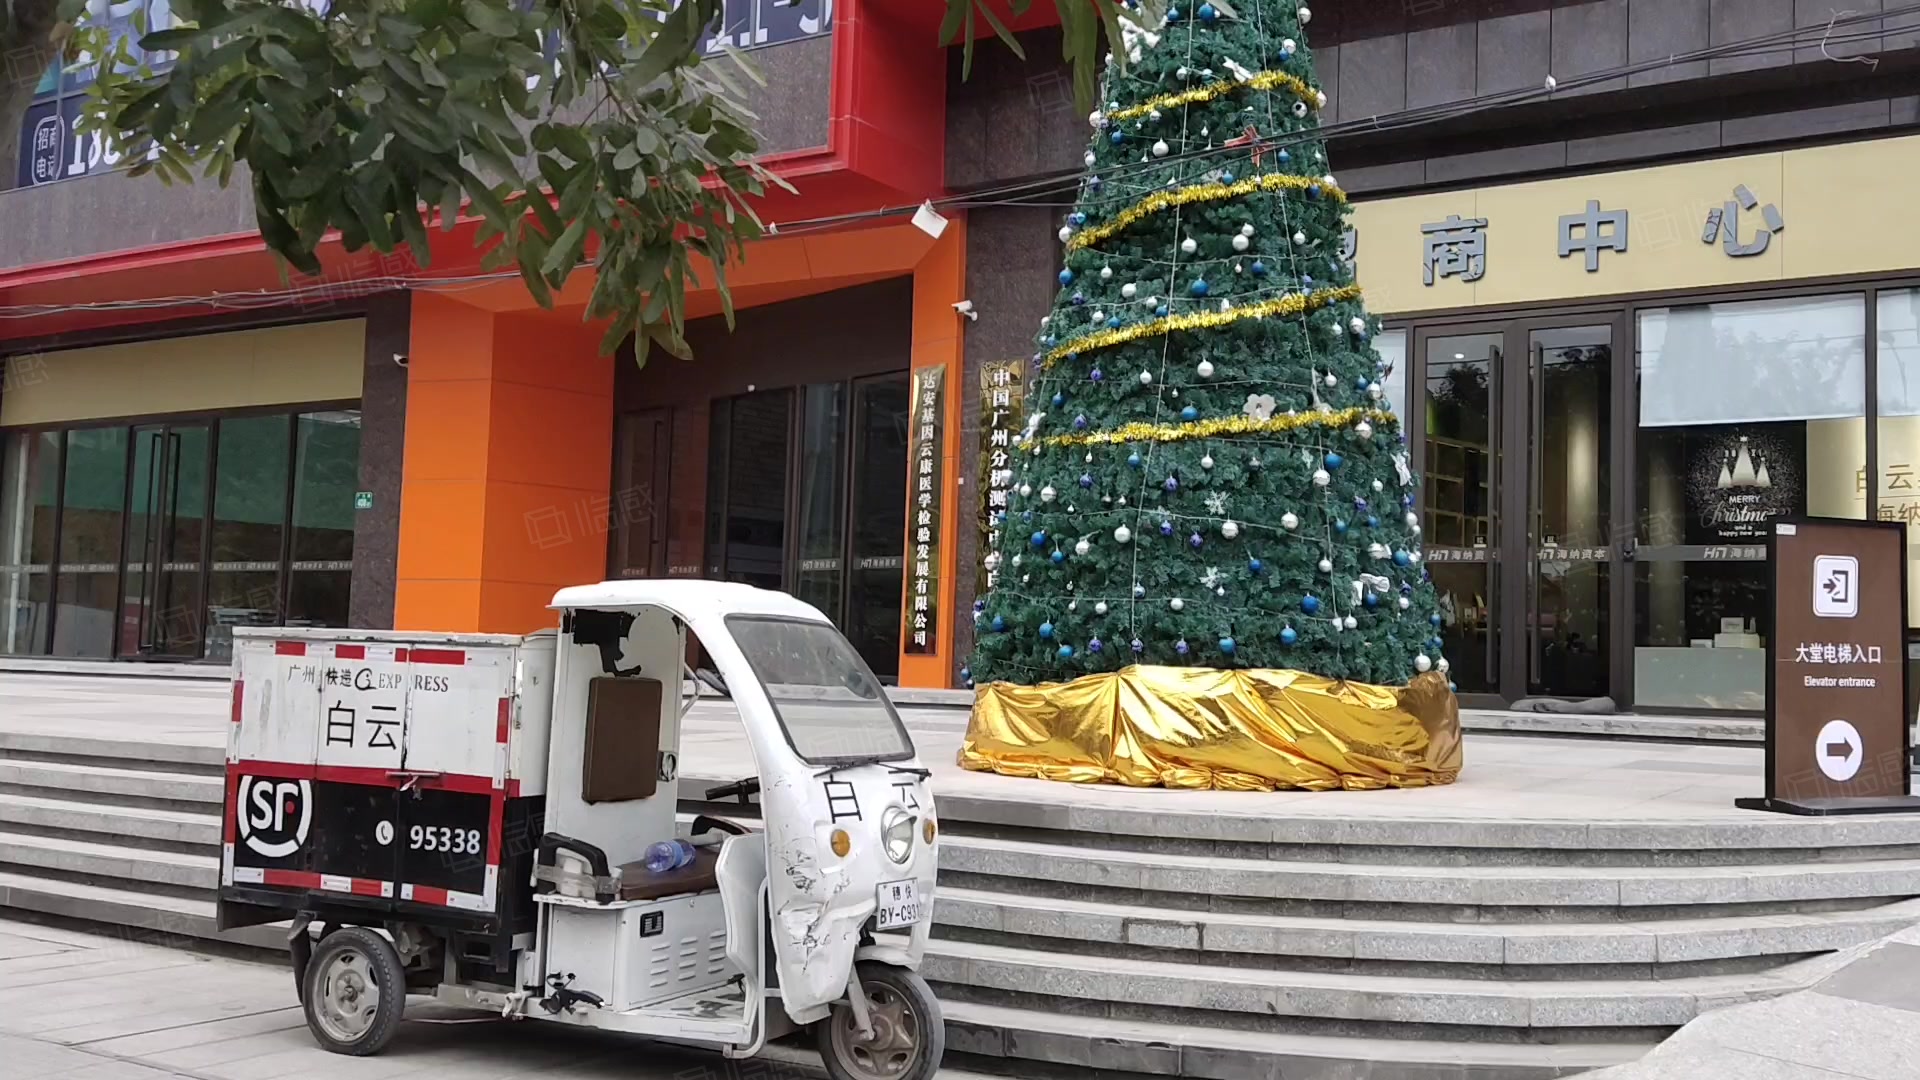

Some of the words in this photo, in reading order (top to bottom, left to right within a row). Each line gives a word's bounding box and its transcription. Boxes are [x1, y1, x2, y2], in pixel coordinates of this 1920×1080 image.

[1338, 183, 1785, 286] 商中心
[1856, 464, 1920, 493] 白云
[913, 374, 937, 647] 达安基因云康医学检验发展有限公司
[1728, 495, 1761, 504] MERRY
[1795, 642, 1882, 664] 大堂电梯入口
[1804, 675, 1837, 688] Elevator
[1838, 677, 1876, 688] entrance
[326, 699, 401, 751] 白云
[408, 824, 482, 855] 95338
